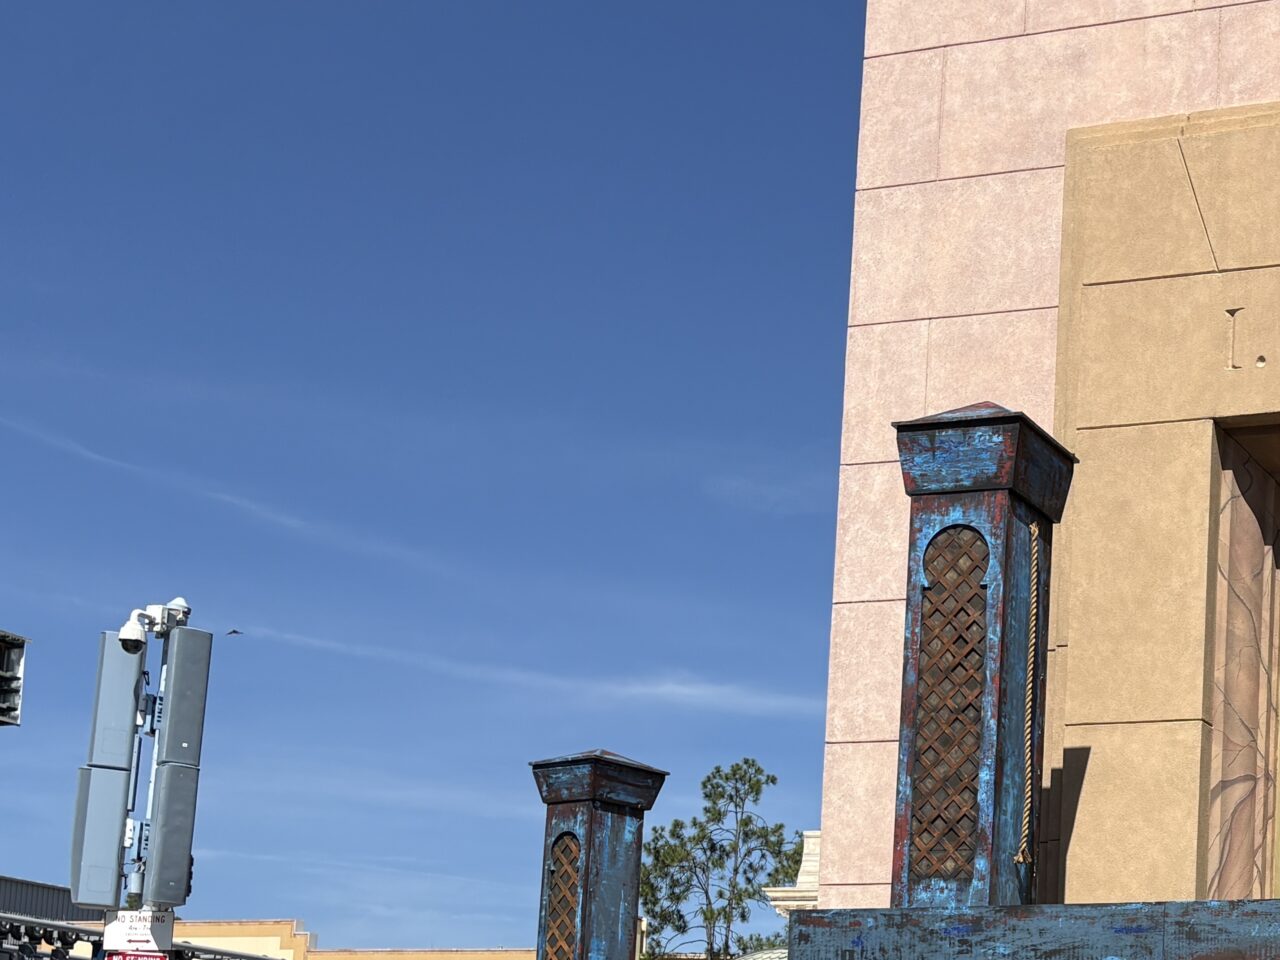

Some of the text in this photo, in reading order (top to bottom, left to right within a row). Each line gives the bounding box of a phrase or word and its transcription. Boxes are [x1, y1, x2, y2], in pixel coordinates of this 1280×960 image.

[1225, 307, 1267, 369] I.
[116, 915, 166, 924] NO STANDING
